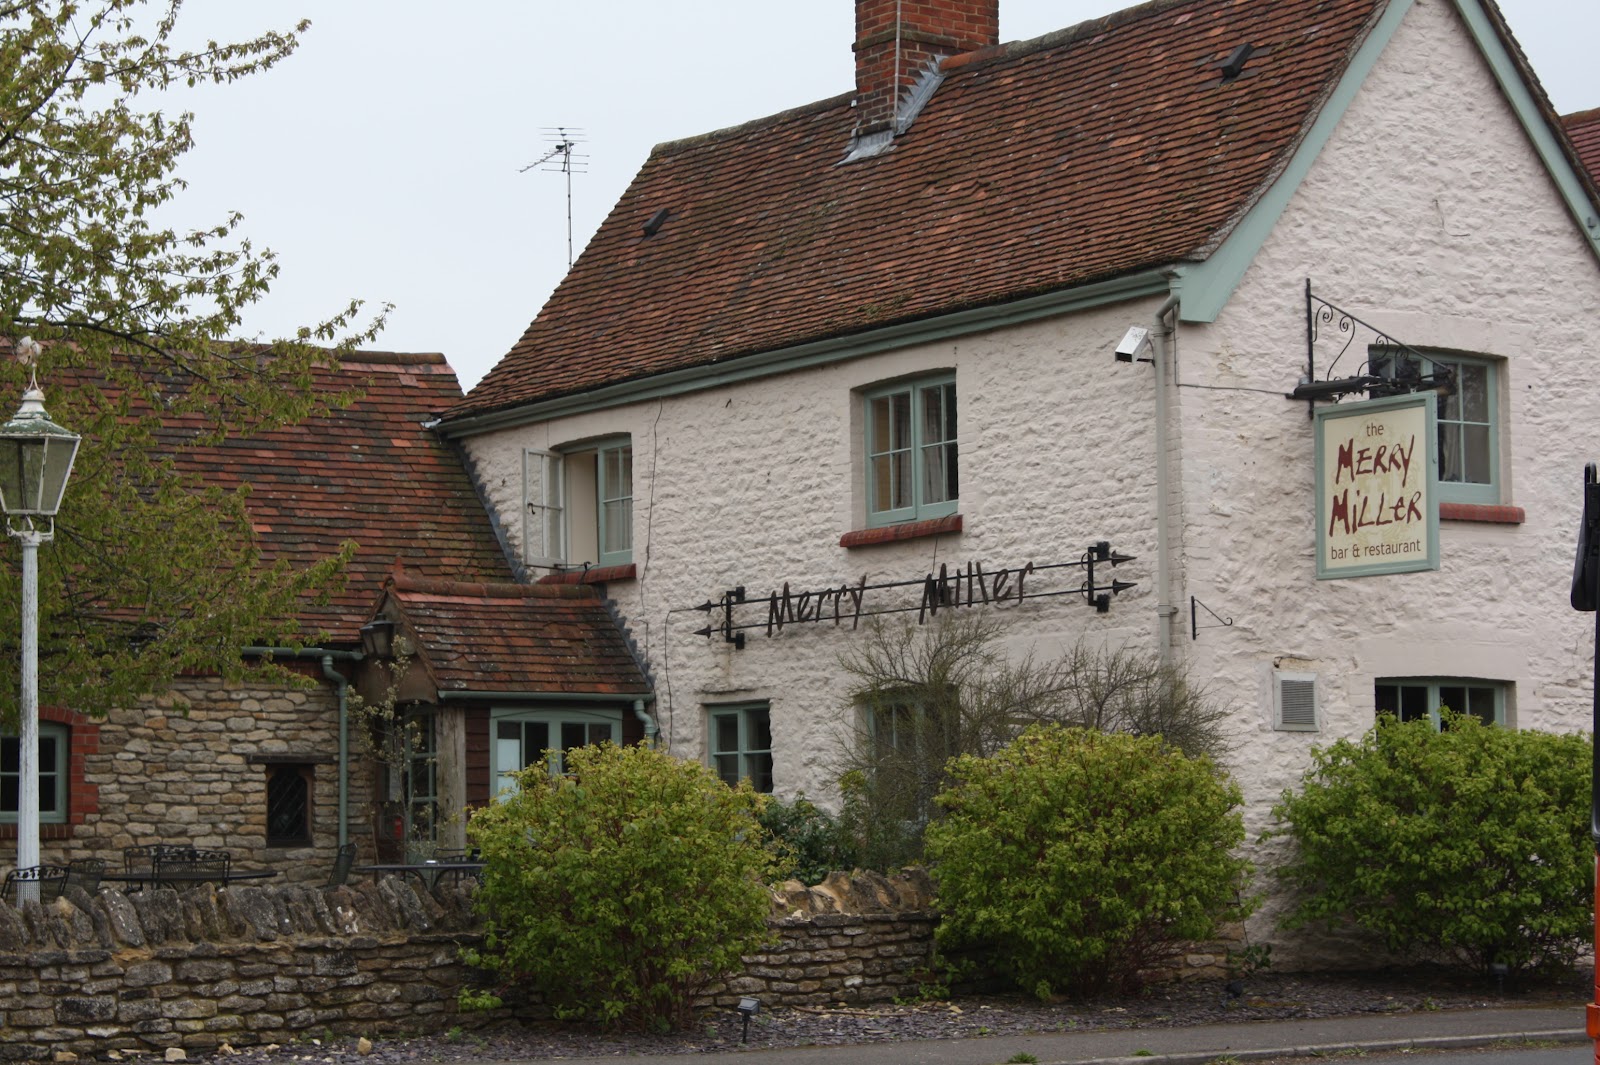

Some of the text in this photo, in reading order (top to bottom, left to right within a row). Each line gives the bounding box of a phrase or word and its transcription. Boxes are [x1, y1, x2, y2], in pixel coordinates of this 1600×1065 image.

[1366, 422, 1384, 437] the
[1331, 538, 1421, 560] bar & restaurant
[766, 561, 1033, 638] Merry Miller
